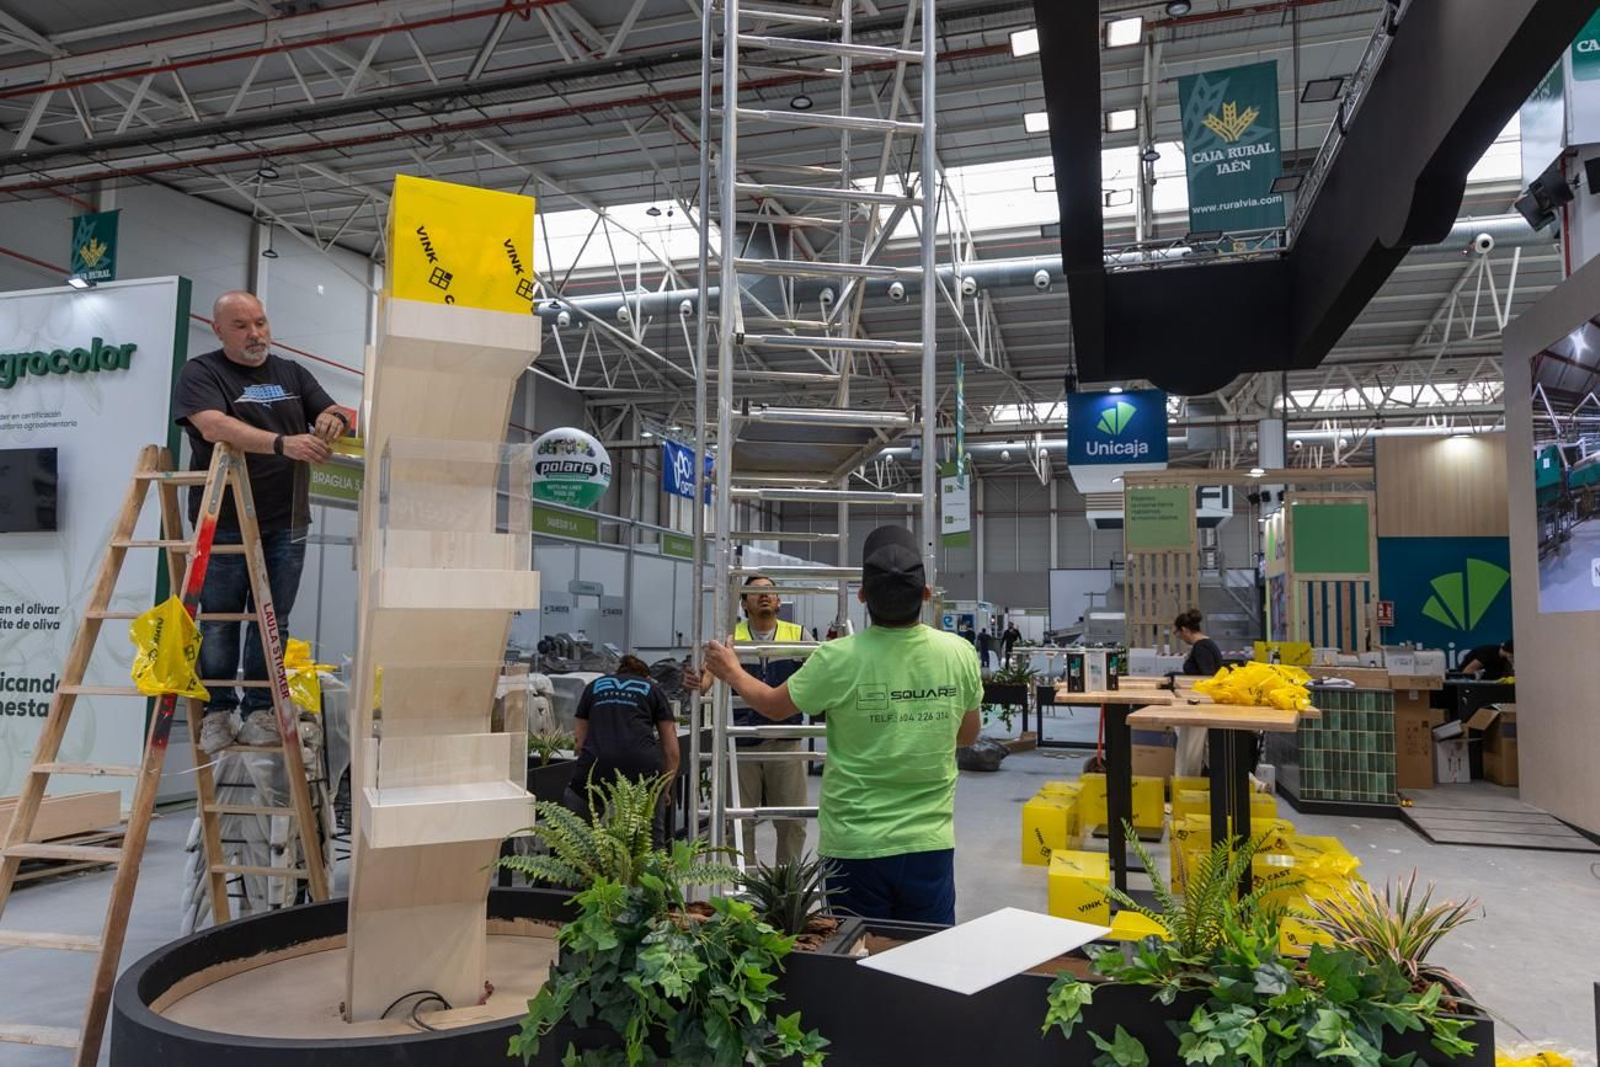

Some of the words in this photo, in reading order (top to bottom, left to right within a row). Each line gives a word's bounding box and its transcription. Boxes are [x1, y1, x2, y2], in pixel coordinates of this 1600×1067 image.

[1191, 149, 1224, 164] CAJA
[1227, 142, 1275, 159] RURAL
[1216, 159, 1251, 176] JAÉN
[1192, 194, 1282, 214] www.ruralvia.com
[416, 225, 438, 264] VINK
[503, 238, 524, 276] VINK
[1086, 440, 1149, 458] Unicaja
[540, 459, 594, 476] polaris
[14, 603, 25, 614] el
[27, 603, 60, 615] olivar
[16, 618, 31, 630] de
[32, 618, 60, 630] oliva
[263, 602, 278, 644] LAULA
[272, 645, 290, 700] STICKER
[890, 687, 957, 700] SQUARE
[1267, 869, 1291, 882] CAST
[1077, 900, 1102, 913] VINK
